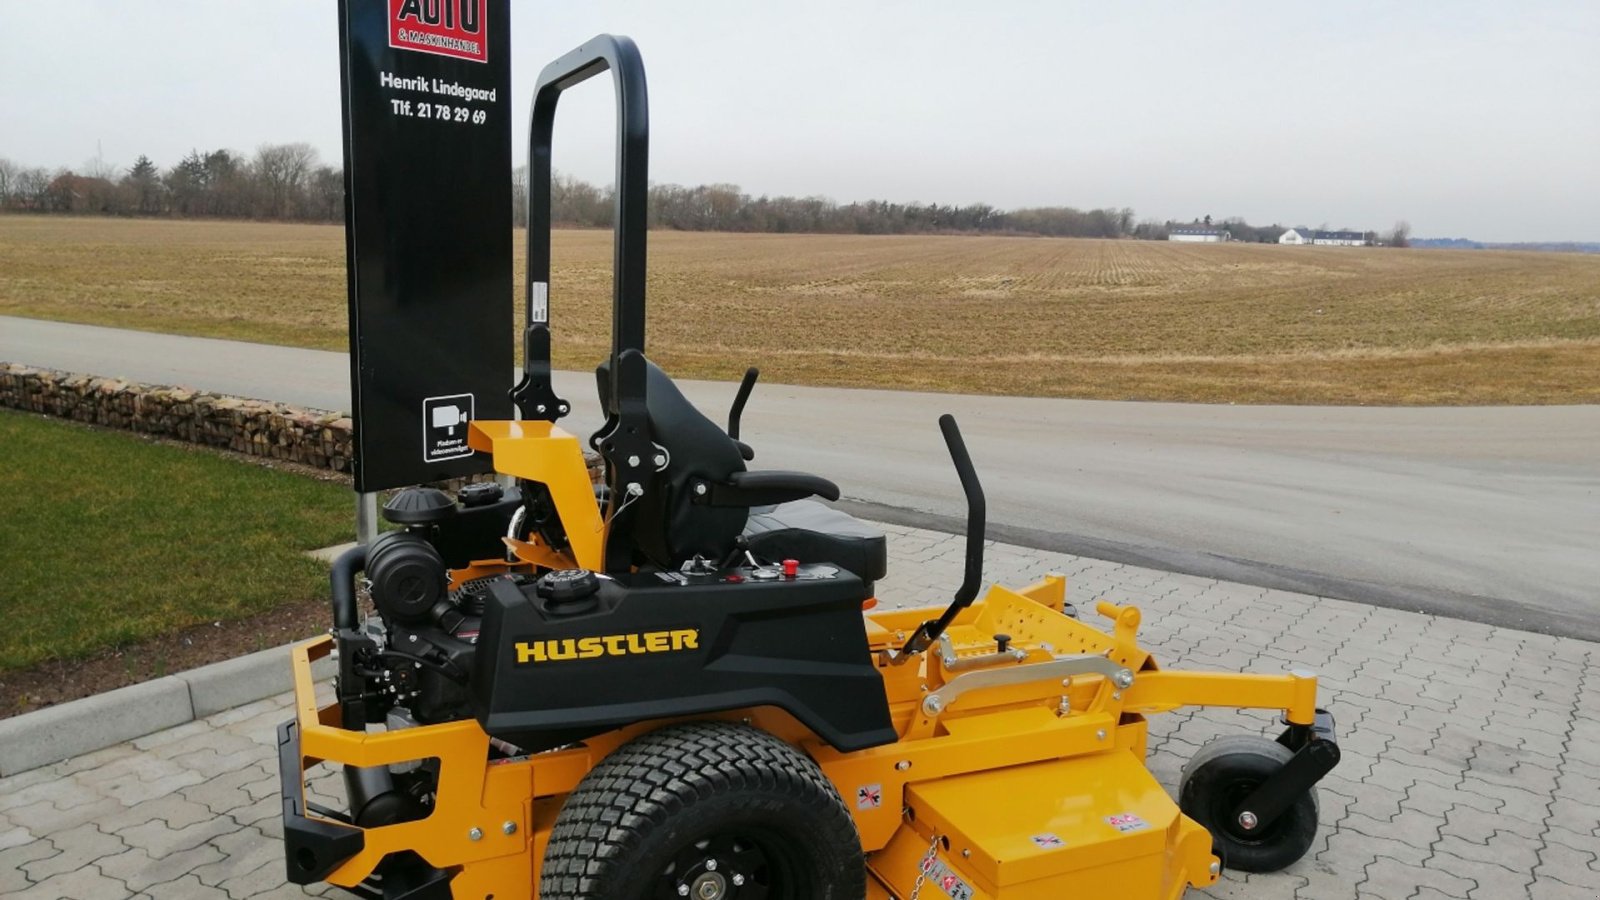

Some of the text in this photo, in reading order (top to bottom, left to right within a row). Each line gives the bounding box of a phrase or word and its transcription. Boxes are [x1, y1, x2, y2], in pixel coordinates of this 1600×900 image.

[398, 28, 481, 54] & MASKINHANDEL
[380, 71, 496, 102] Henrik Lindegaard
[390, 99, 487, 125] Tlf. 21 78 29 69
[514, 629, 699, 663] HUSTLER
